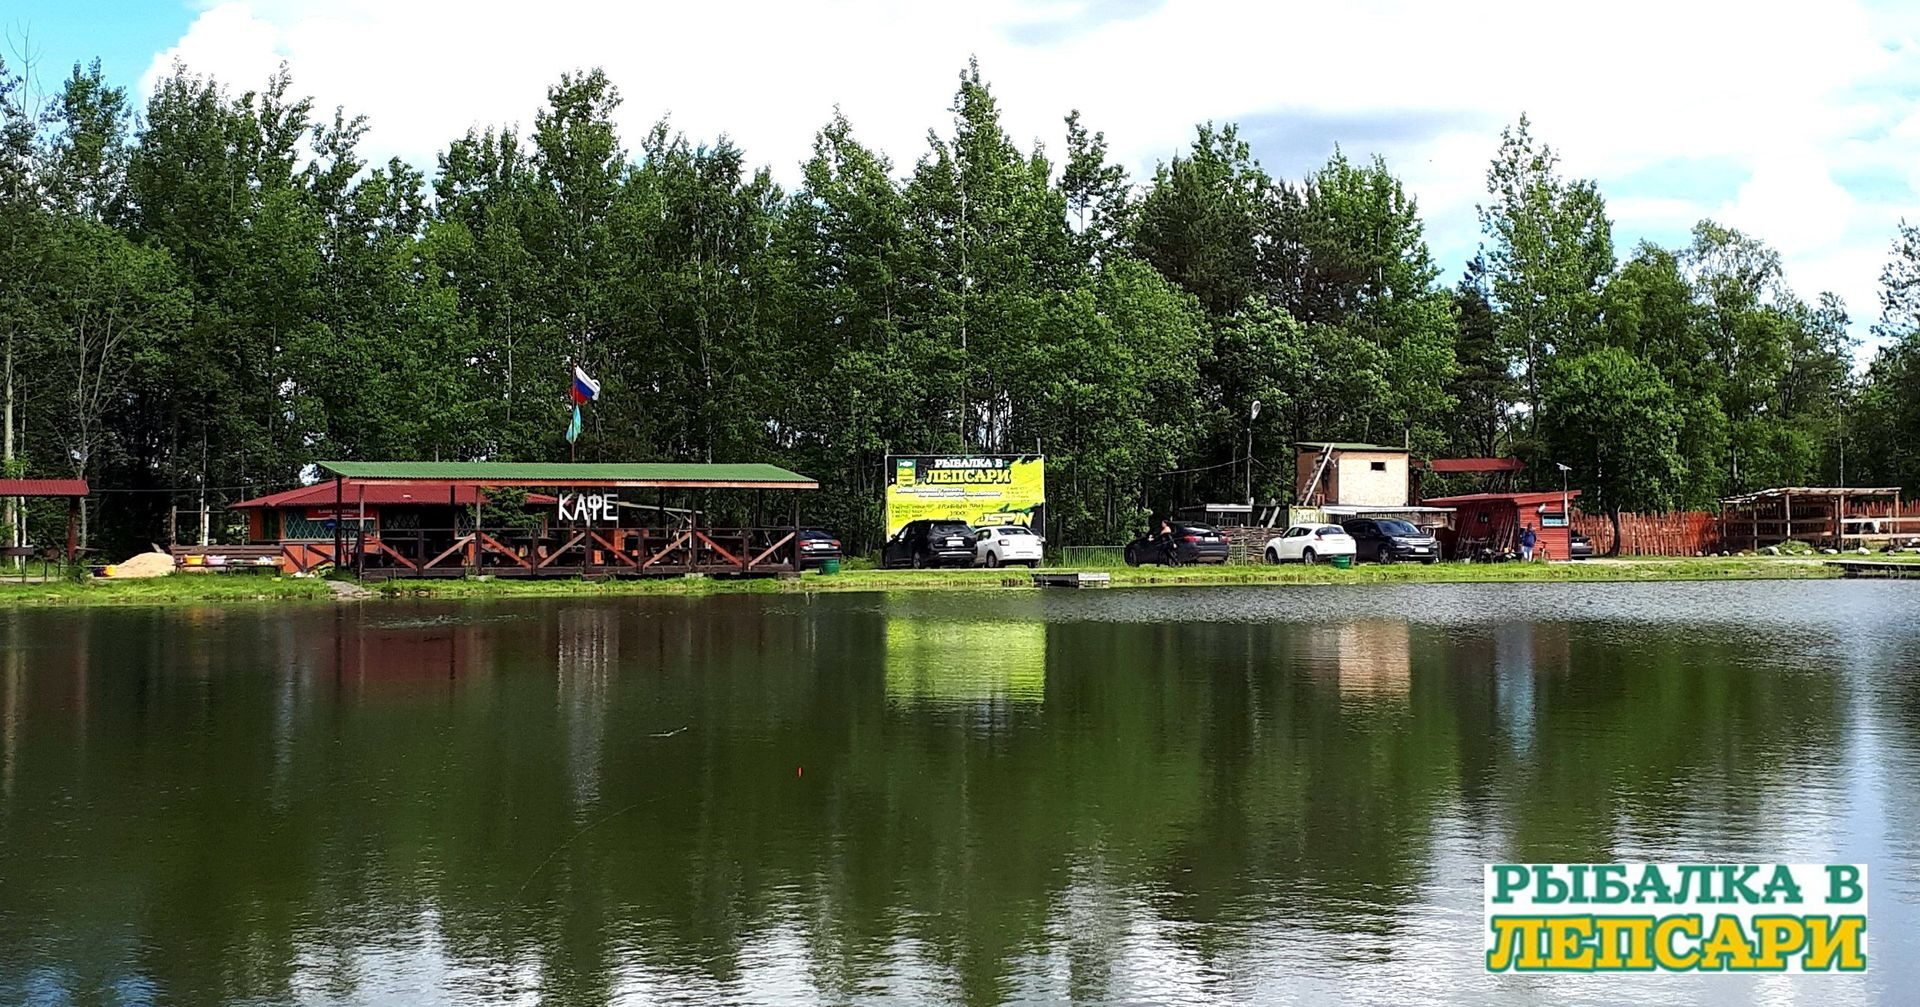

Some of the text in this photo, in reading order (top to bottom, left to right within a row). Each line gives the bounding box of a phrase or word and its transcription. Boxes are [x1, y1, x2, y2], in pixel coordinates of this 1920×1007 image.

[934, 458, 1003, 469] РЫБАЛКА В
[926, 469, 1011, 484] ЛЕПСАРИ
[558, 493, 618, 521] КАФЕ
[975, 511, 1035, 528] JSPIN
